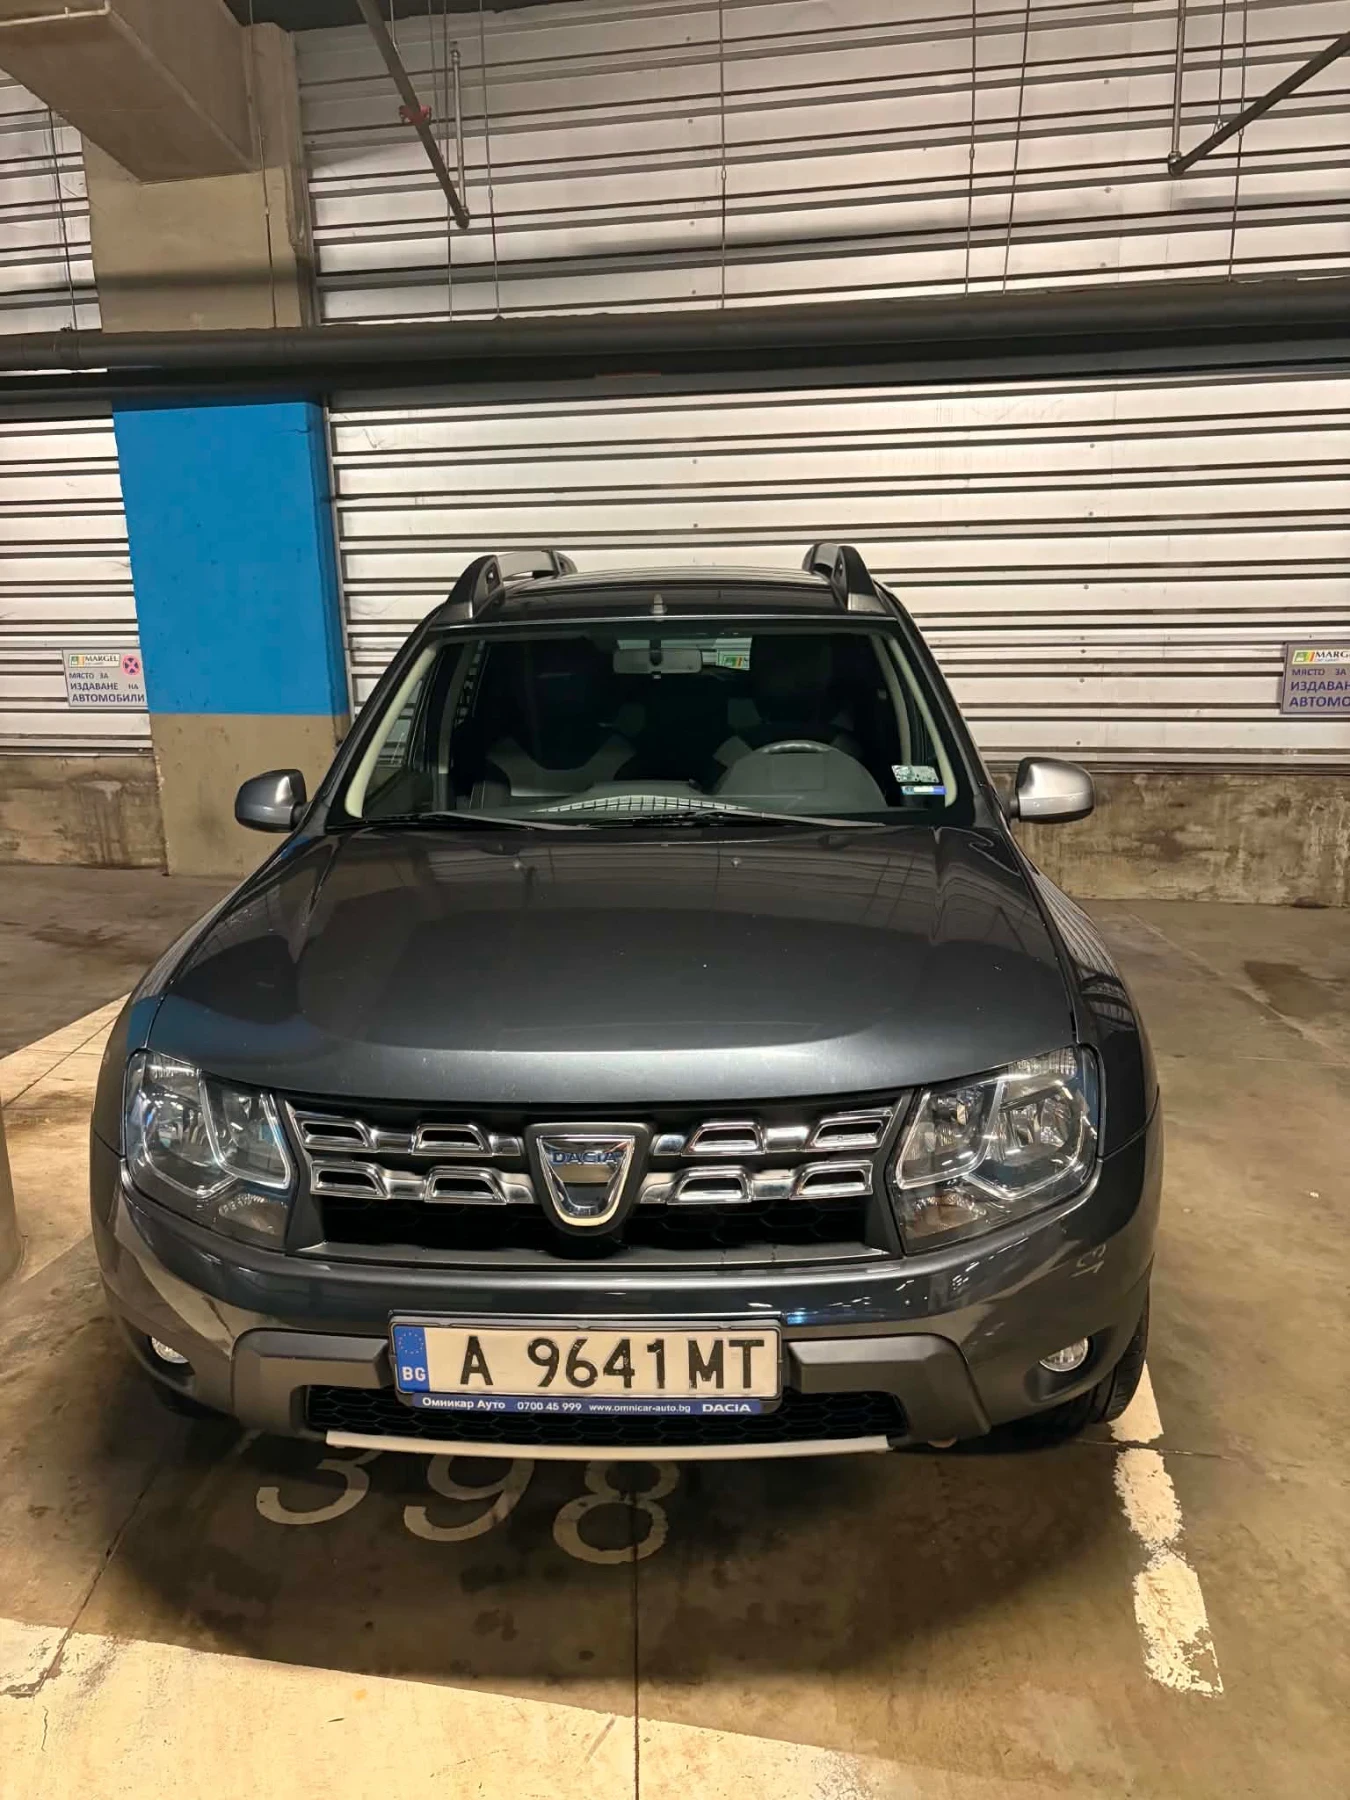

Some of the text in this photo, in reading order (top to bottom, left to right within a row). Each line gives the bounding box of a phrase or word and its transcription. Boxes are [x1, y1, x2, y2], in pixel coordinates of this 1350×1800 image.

[1292, 668, 1346, 676] МЯСТО ЗА
[70, 682, 119, 691] ИЗДАВАНЕ
[72, 693, 145, 703] АВТОМОБИЛИ
[551, 1151, 618, 1163] DACIA
[459, 1335, 765, 1389] A 9641 MT
[402, 1366, 426, 1382] BG
[422, 1397, 505, 1410] Омникар Ауто
[517, 1402, 582, 1412] 0700 45 999
[589, 1403, 691, 1413] www.omnicar-auto.bg
[702, 1403, 752, 1413] DACIA
